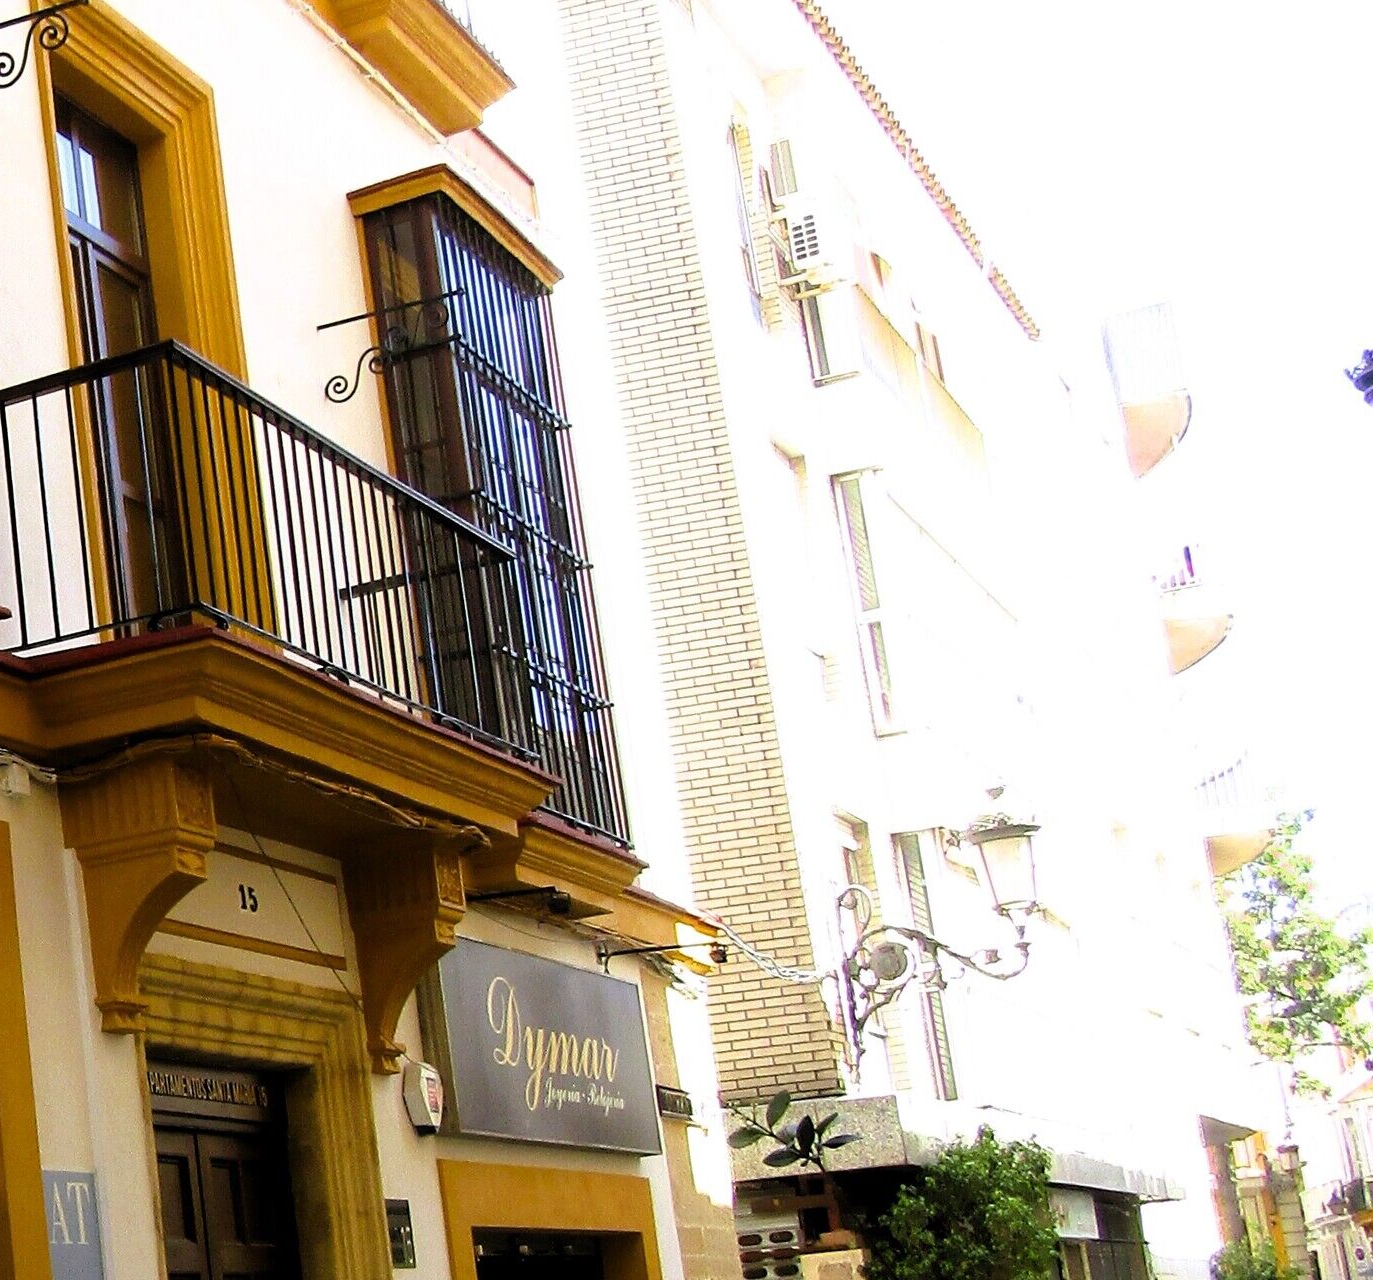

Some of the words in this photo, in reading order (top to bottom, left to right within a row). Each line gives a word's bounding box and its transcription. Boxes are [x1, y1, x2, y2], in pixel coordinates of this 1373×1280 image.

[238, 883, 258, 913] 15
[487, 976, 619, 1111] Dymar
[147, 1071, 207, 1099] PARTAMENTOS
[50, 1181, 90, 1245] AT
